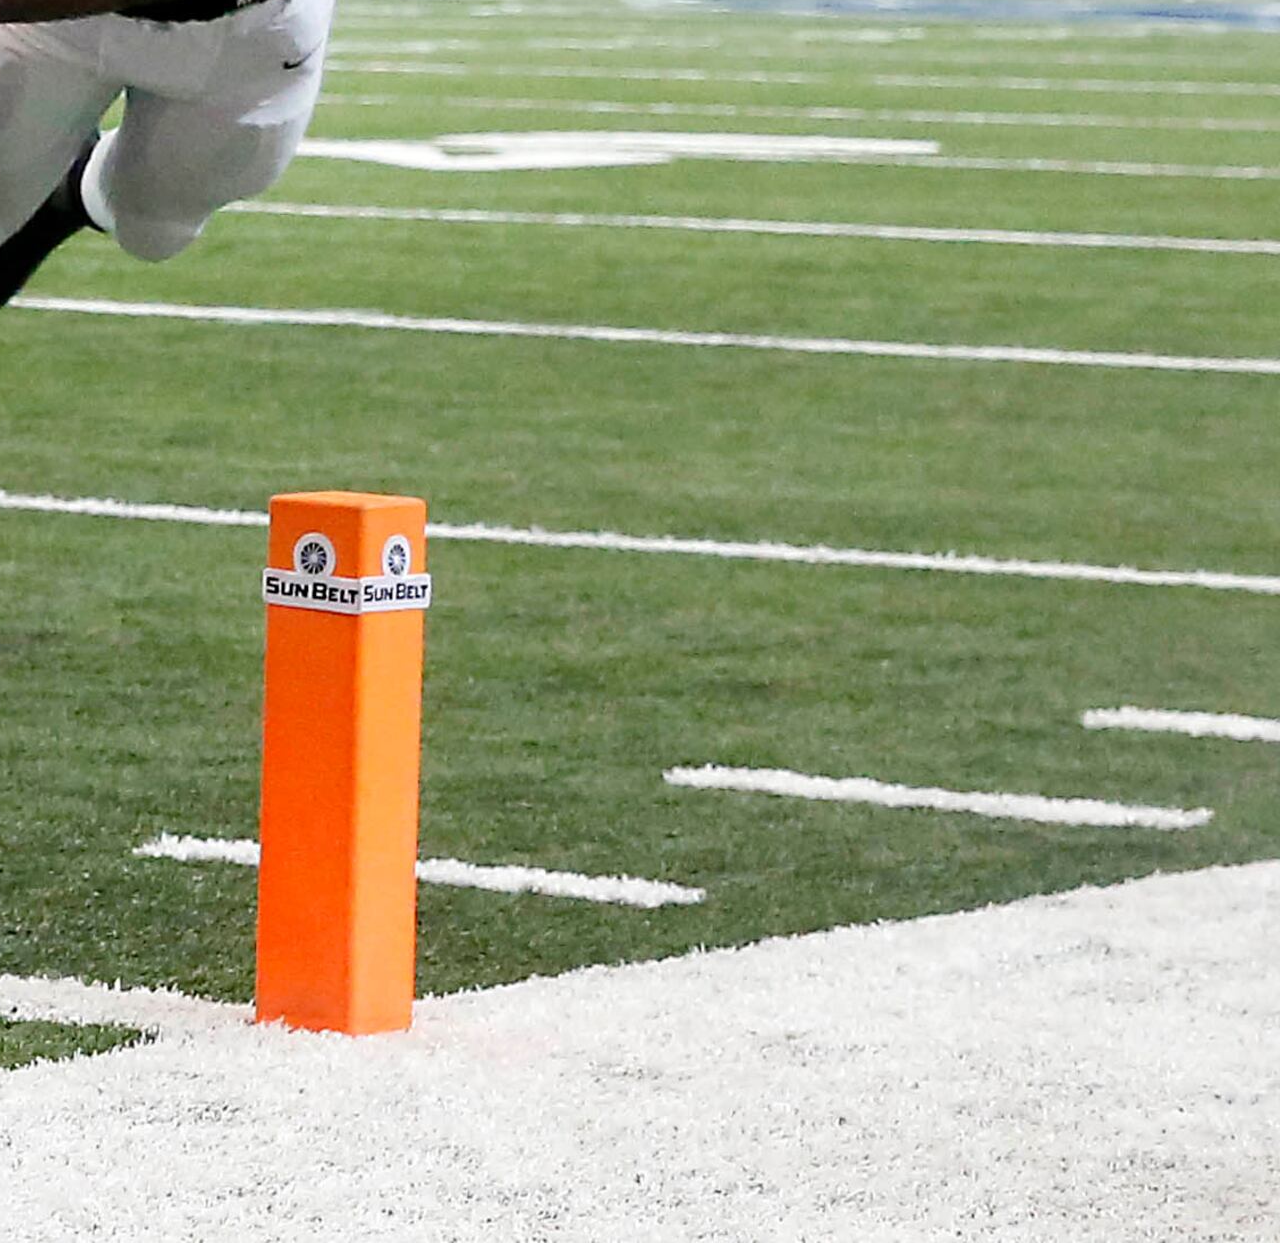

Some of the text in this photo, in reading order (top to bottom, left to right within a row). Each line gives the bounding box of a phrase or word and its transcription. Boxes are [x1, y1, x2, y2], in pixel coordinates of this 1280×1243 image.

[265, 576, 359, 605] SUN BELT
[363, 583, 429, 603] SUN BELT
